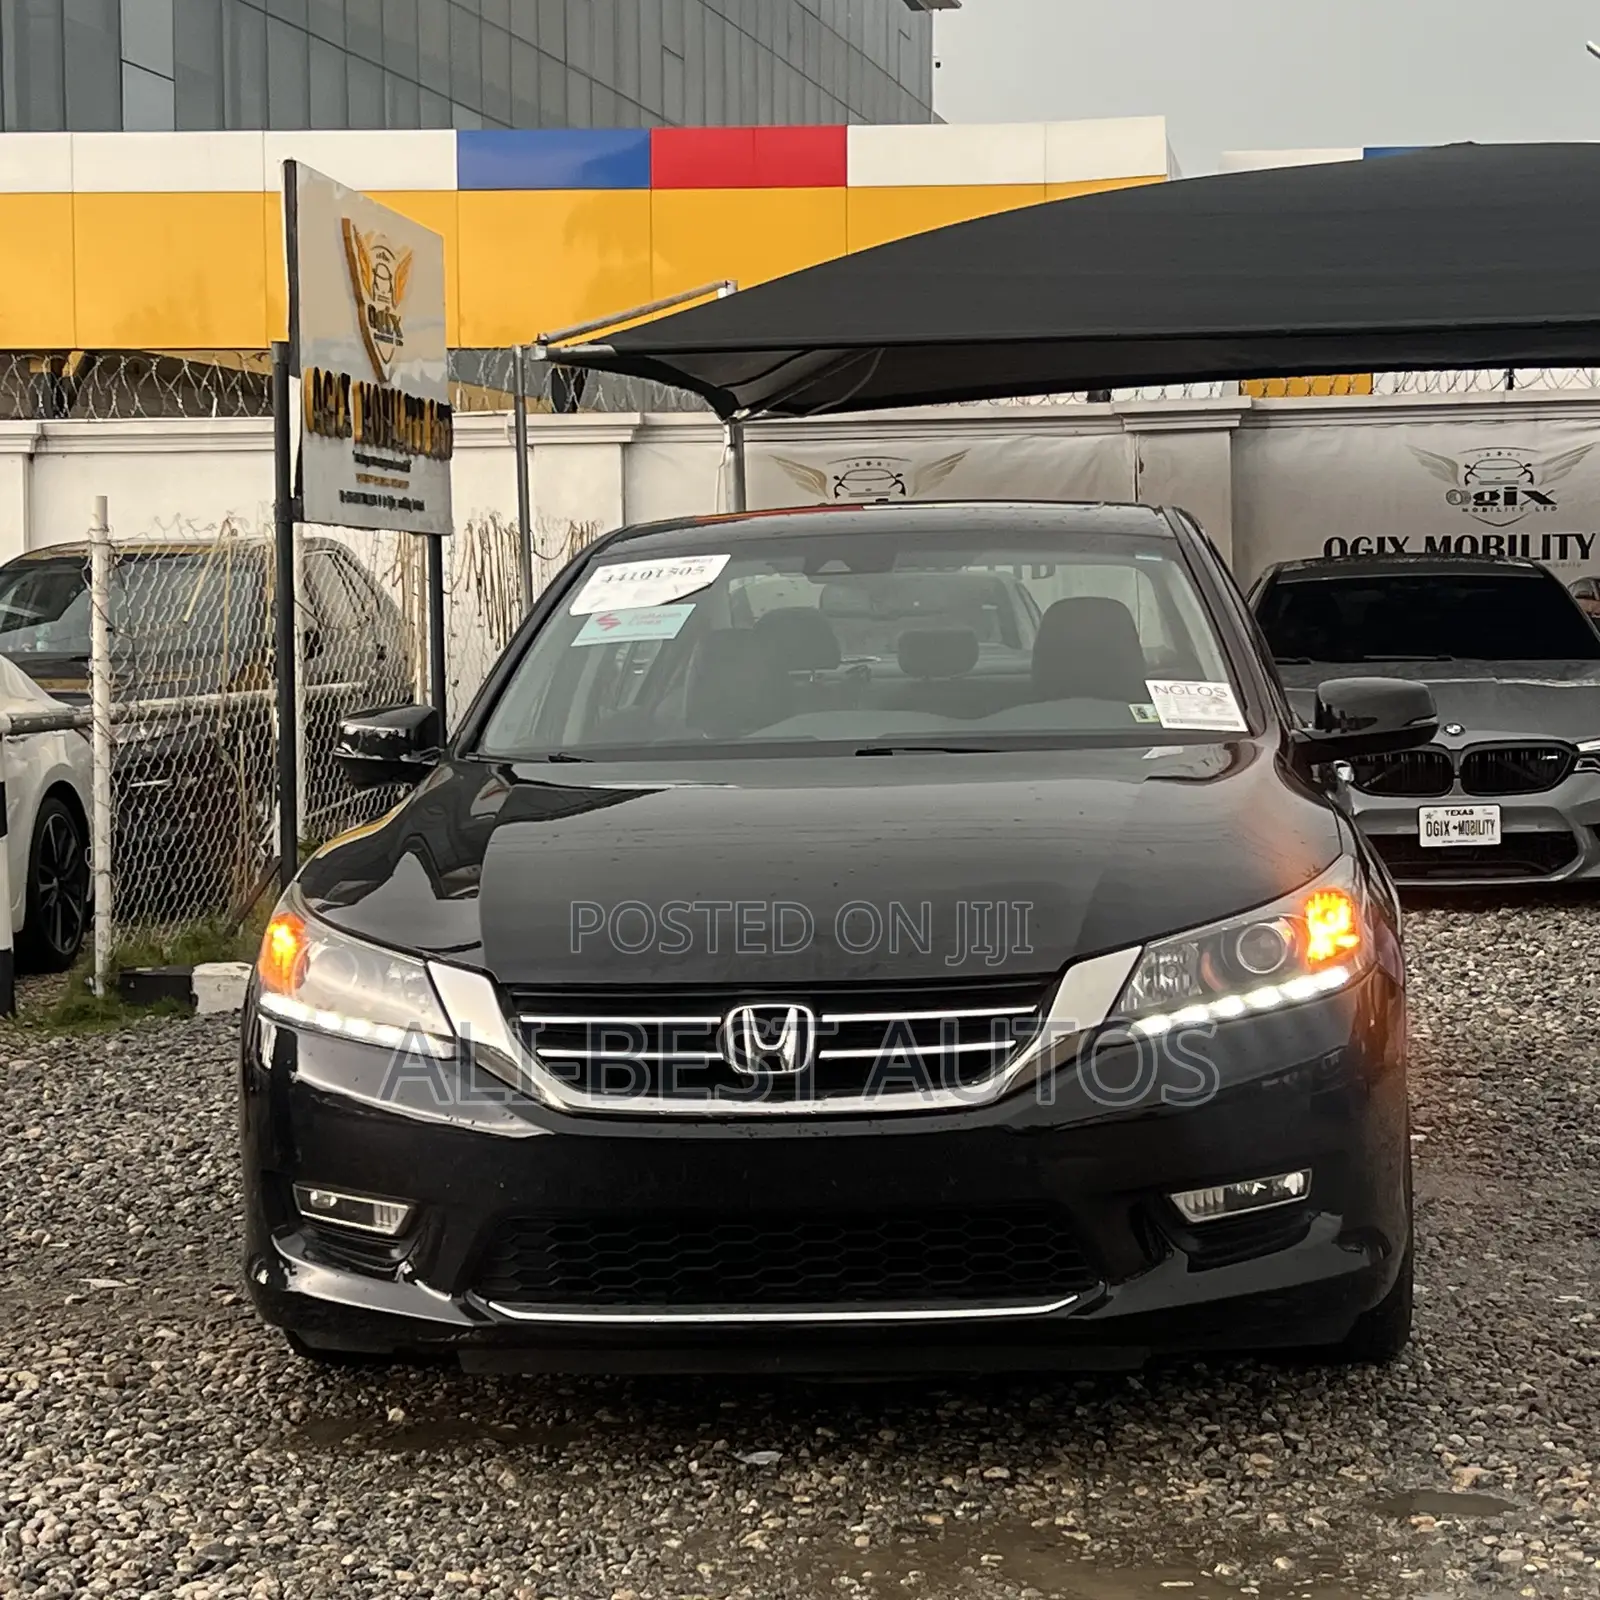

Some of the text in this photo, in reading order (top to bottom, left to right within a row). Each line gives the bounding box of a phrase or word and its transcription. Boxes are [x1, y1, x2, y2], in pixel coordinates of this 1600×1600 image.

[1323, 533, 1597, 560] OGIX MOBILITY
[1153, 685, 1228, 698] NGLOS
[1445, 808, 1474, 817] TEXAS
